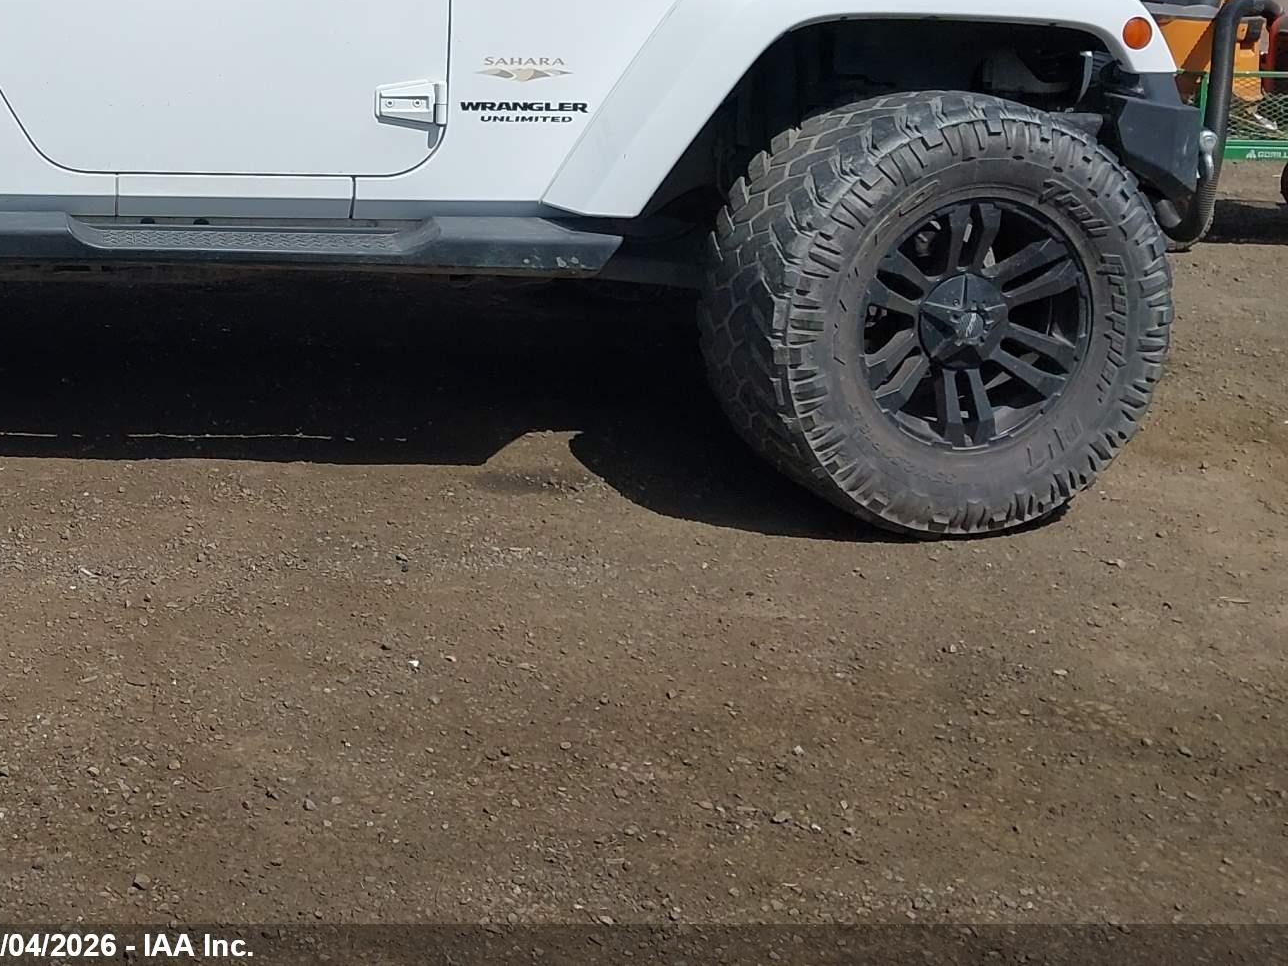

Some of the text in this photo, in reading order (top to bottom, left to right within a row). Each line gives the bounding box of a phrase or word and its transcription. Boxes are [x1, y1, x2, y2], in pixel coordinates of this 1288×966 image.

[483, 56, 565, 66] SAHARA
[460, 101, 589, 114] WRANGLER
[480, 115, 574, 123] UNLIMITED
